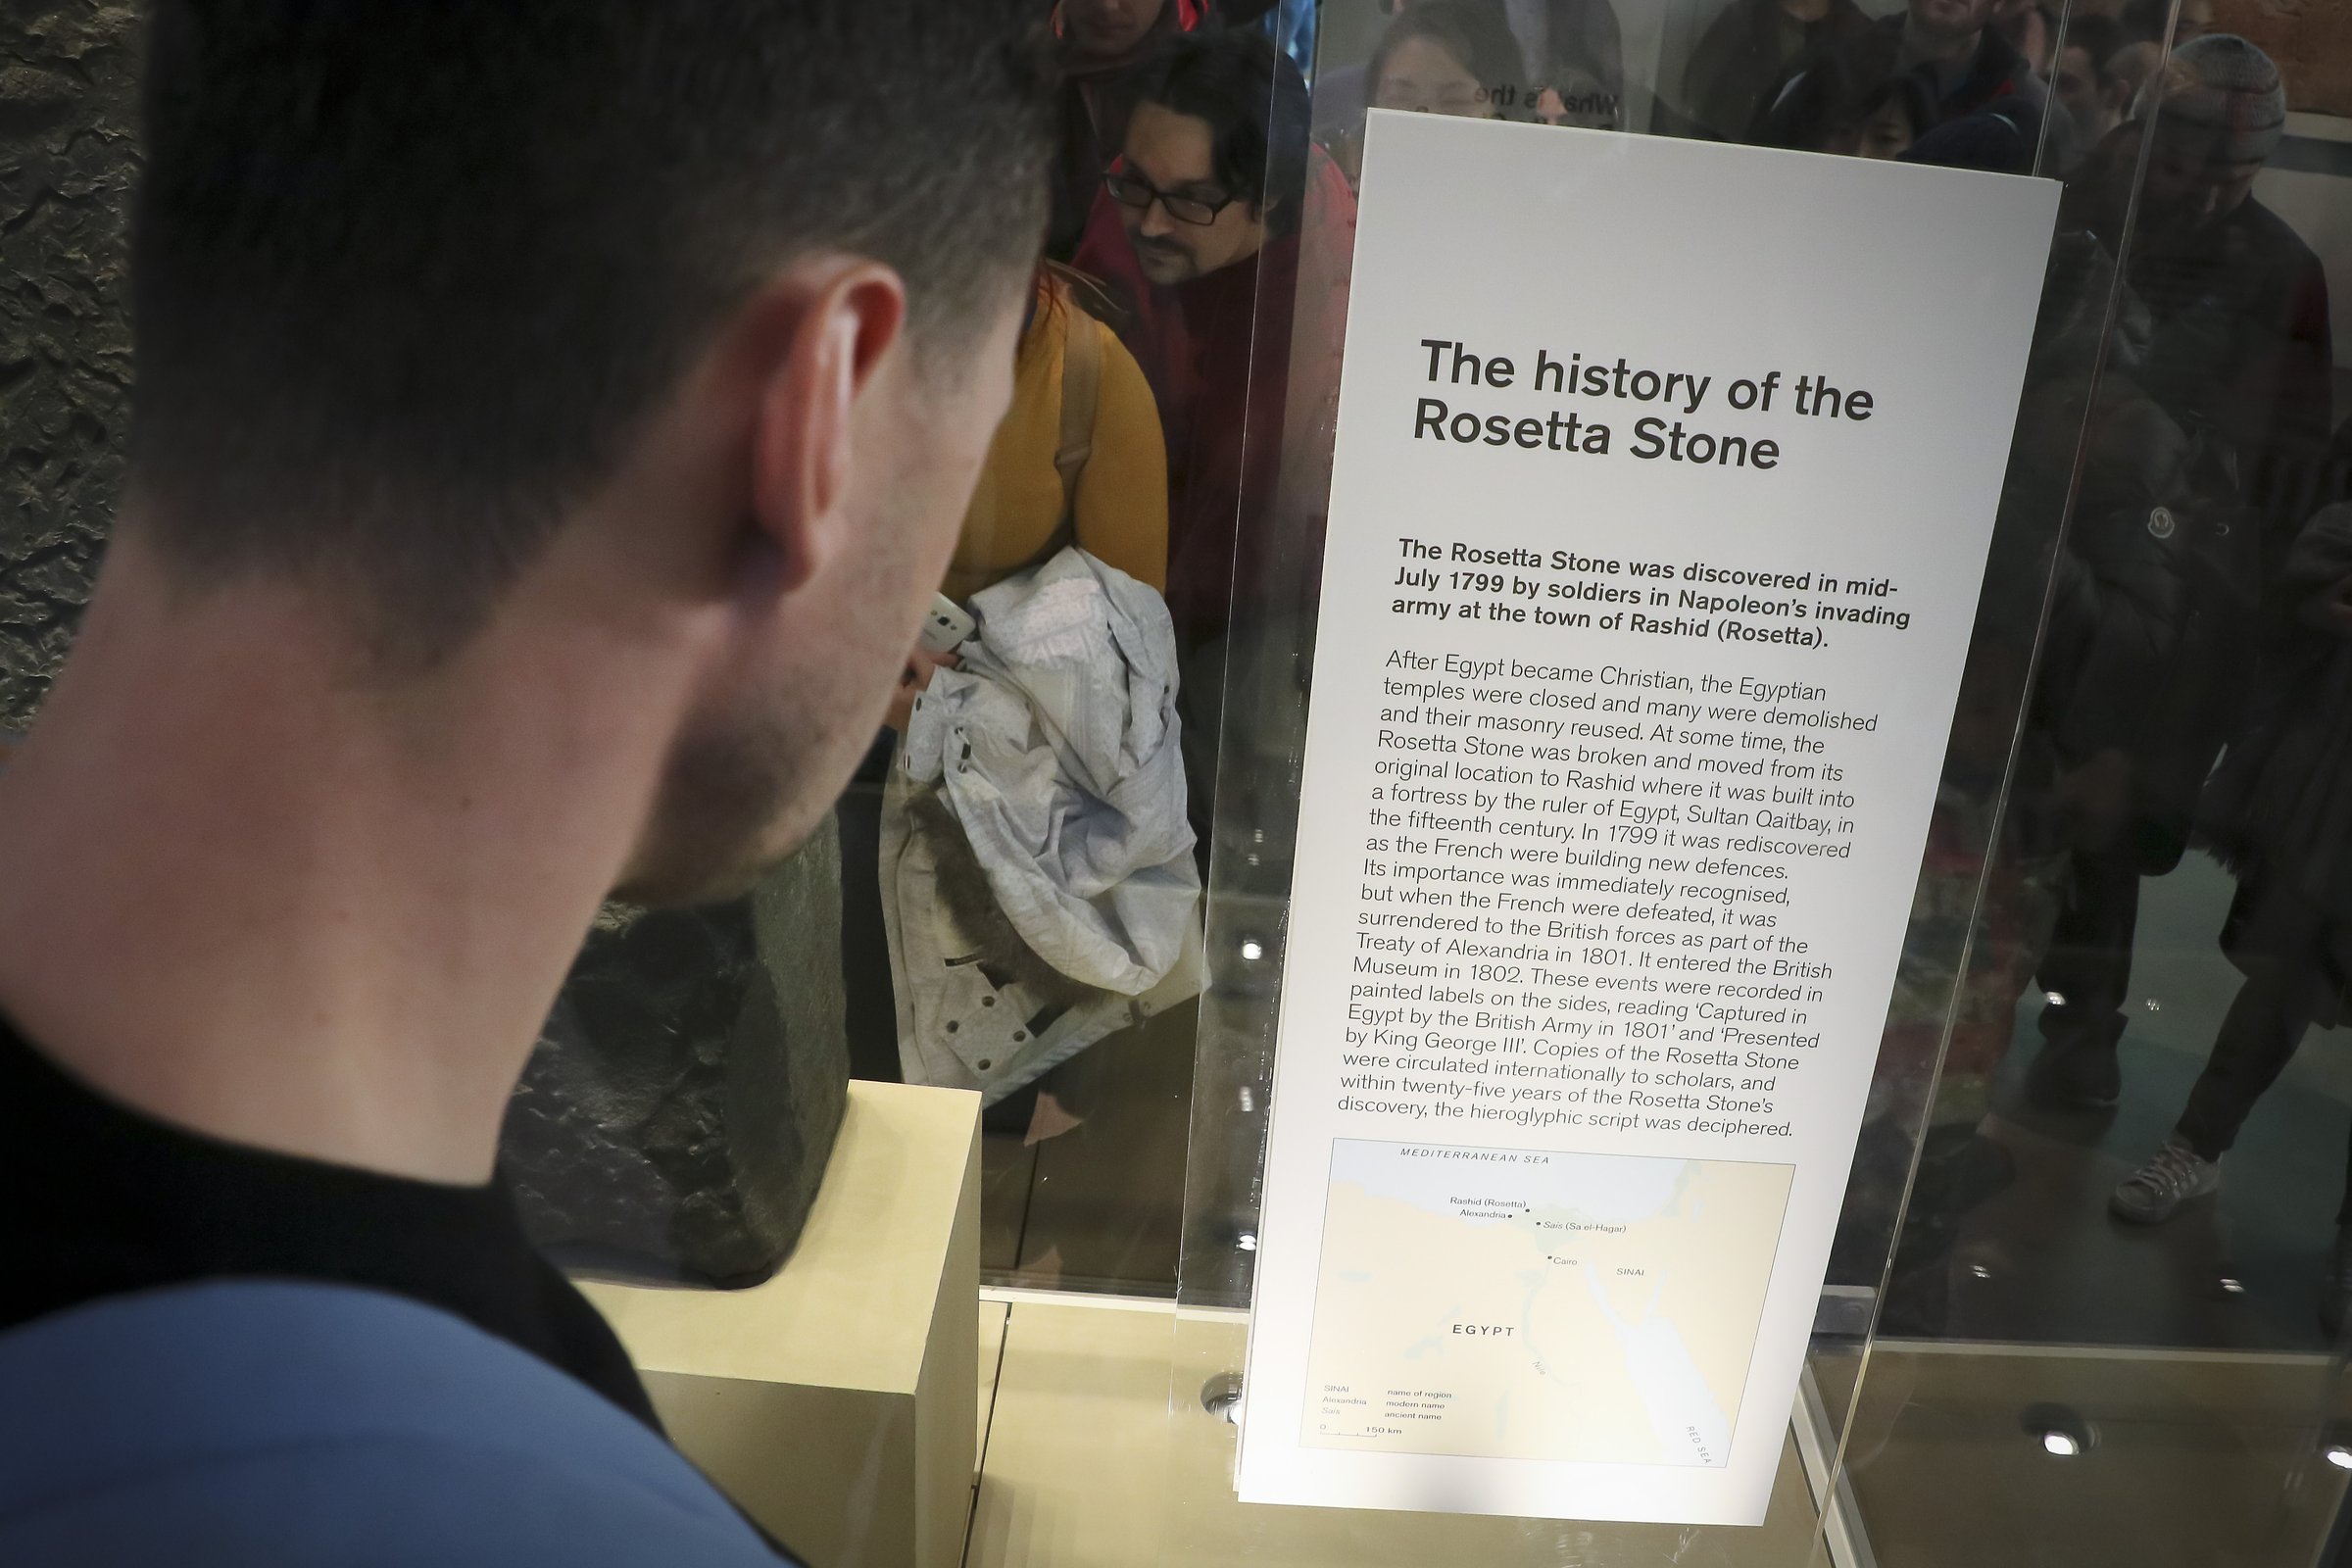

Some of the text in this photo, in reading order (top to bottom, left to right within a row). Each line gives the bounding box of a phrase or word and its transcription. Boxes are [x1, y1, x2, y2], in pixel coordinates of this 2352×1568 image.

[1419, 337, 1874, 421] The history of the
[1413, 396, 1780, 470] Rosetta Stone
[1397, 536, 1898, 598] The Rosetta Stone was discovered in mid-
[1393, 564, 1441, 592] July
[1448, 569, 1504, 593] 1799
[1511, 574, 1541, 601] by
[1545, 579, 1642, 605] soldiers
[1647, 585, 1670, 607] in
[1813, 599, 1911, 630] invading
[1391, 598, 1829, 651] army at the town of Rashid (Rosetta).
[1384, 648, 1827, 705] After Egypt became Christian, the Egyptian
[1373, 756, 1855, 808] original location to Rashid where it was built into
[1370, 781, 1854, 837] a fortress by the ruler of Egypt, Sultan Qaitbay, in
[1365, 834, 1788, 880] as the French were building new defences.
[1360, 881, 1778, 928] but when the French were defeated, it was
[1354, 930, 1833, 980] Treaty of Alexandria in 1801. It entered the British
[1352, 955, 1823, 1003] Museum in 1802. These events were recorded in
[1348, 980, 1423, 1002] painted
[1428, 983, 1485, 1005] labels
[1490, 993, 1514, 1006] on
[1520, 991, 1552, 1009] the
[1556, 993, 1610, 1016] sides,
[1616, 999, 1689, 1022] reading
[1789, 1007, 1807, 1025] in
[1345, 1025, 1368, 1049] by
[1373, 1027, 1418, 1052] King
[1423, 1030, 1496, 1056] George
[1532, 1037, 1599, 1061] Copies
[1603, 1043, 1626, 1060] of
[1629, 1044, 1660, 1062] the
[1665, 1046, 1739, 1067] Rosetta
[1742, 1050, 1799, 1070] Stone
[1339, 1072, 1396, 1092] within
[1400, 1075, 1506, 1101] twenty-five
[1508, 1087, 1562, 1103] years
[1567, 1086, 1589, 1103] of
[1592, 1087, 1623, 1105] the
[1627, 1089, 1700, 1110] Rosetta
[1342, 1053, 1777, 1092] were circulated internationally to scholars, and
[1337, 1094, 1792, 1138] discovery, the hieroglyphic script was deciphered.
[1400, 1148, 1549, 1165] MEDITERRANEAN SEA
[1449, 1196, 1527, 1209] Rashid (Rosetta)
[1459, 1208, 1506, 1219] Alexandria
[1543, 1220, 1627, 1235] Sais (Sa el-Hagar)
[1552, 1256, 1578, 1266] Cairo
[1616, 1267, 1645, 1277] SINAI
[1452, 1323, 1515, 1338] EGYPT
[1322, 1396, 1367, 1405] Alexandria
[1384, 1411, 1417, 1420] ancient
[1385, 1399, 1419, 1408] modern
[1413, 1389, 1423, 1397] of
[1424, 1391, 1453, 1399] region
[1686, 1426, 1713, 1464] RED SEA
